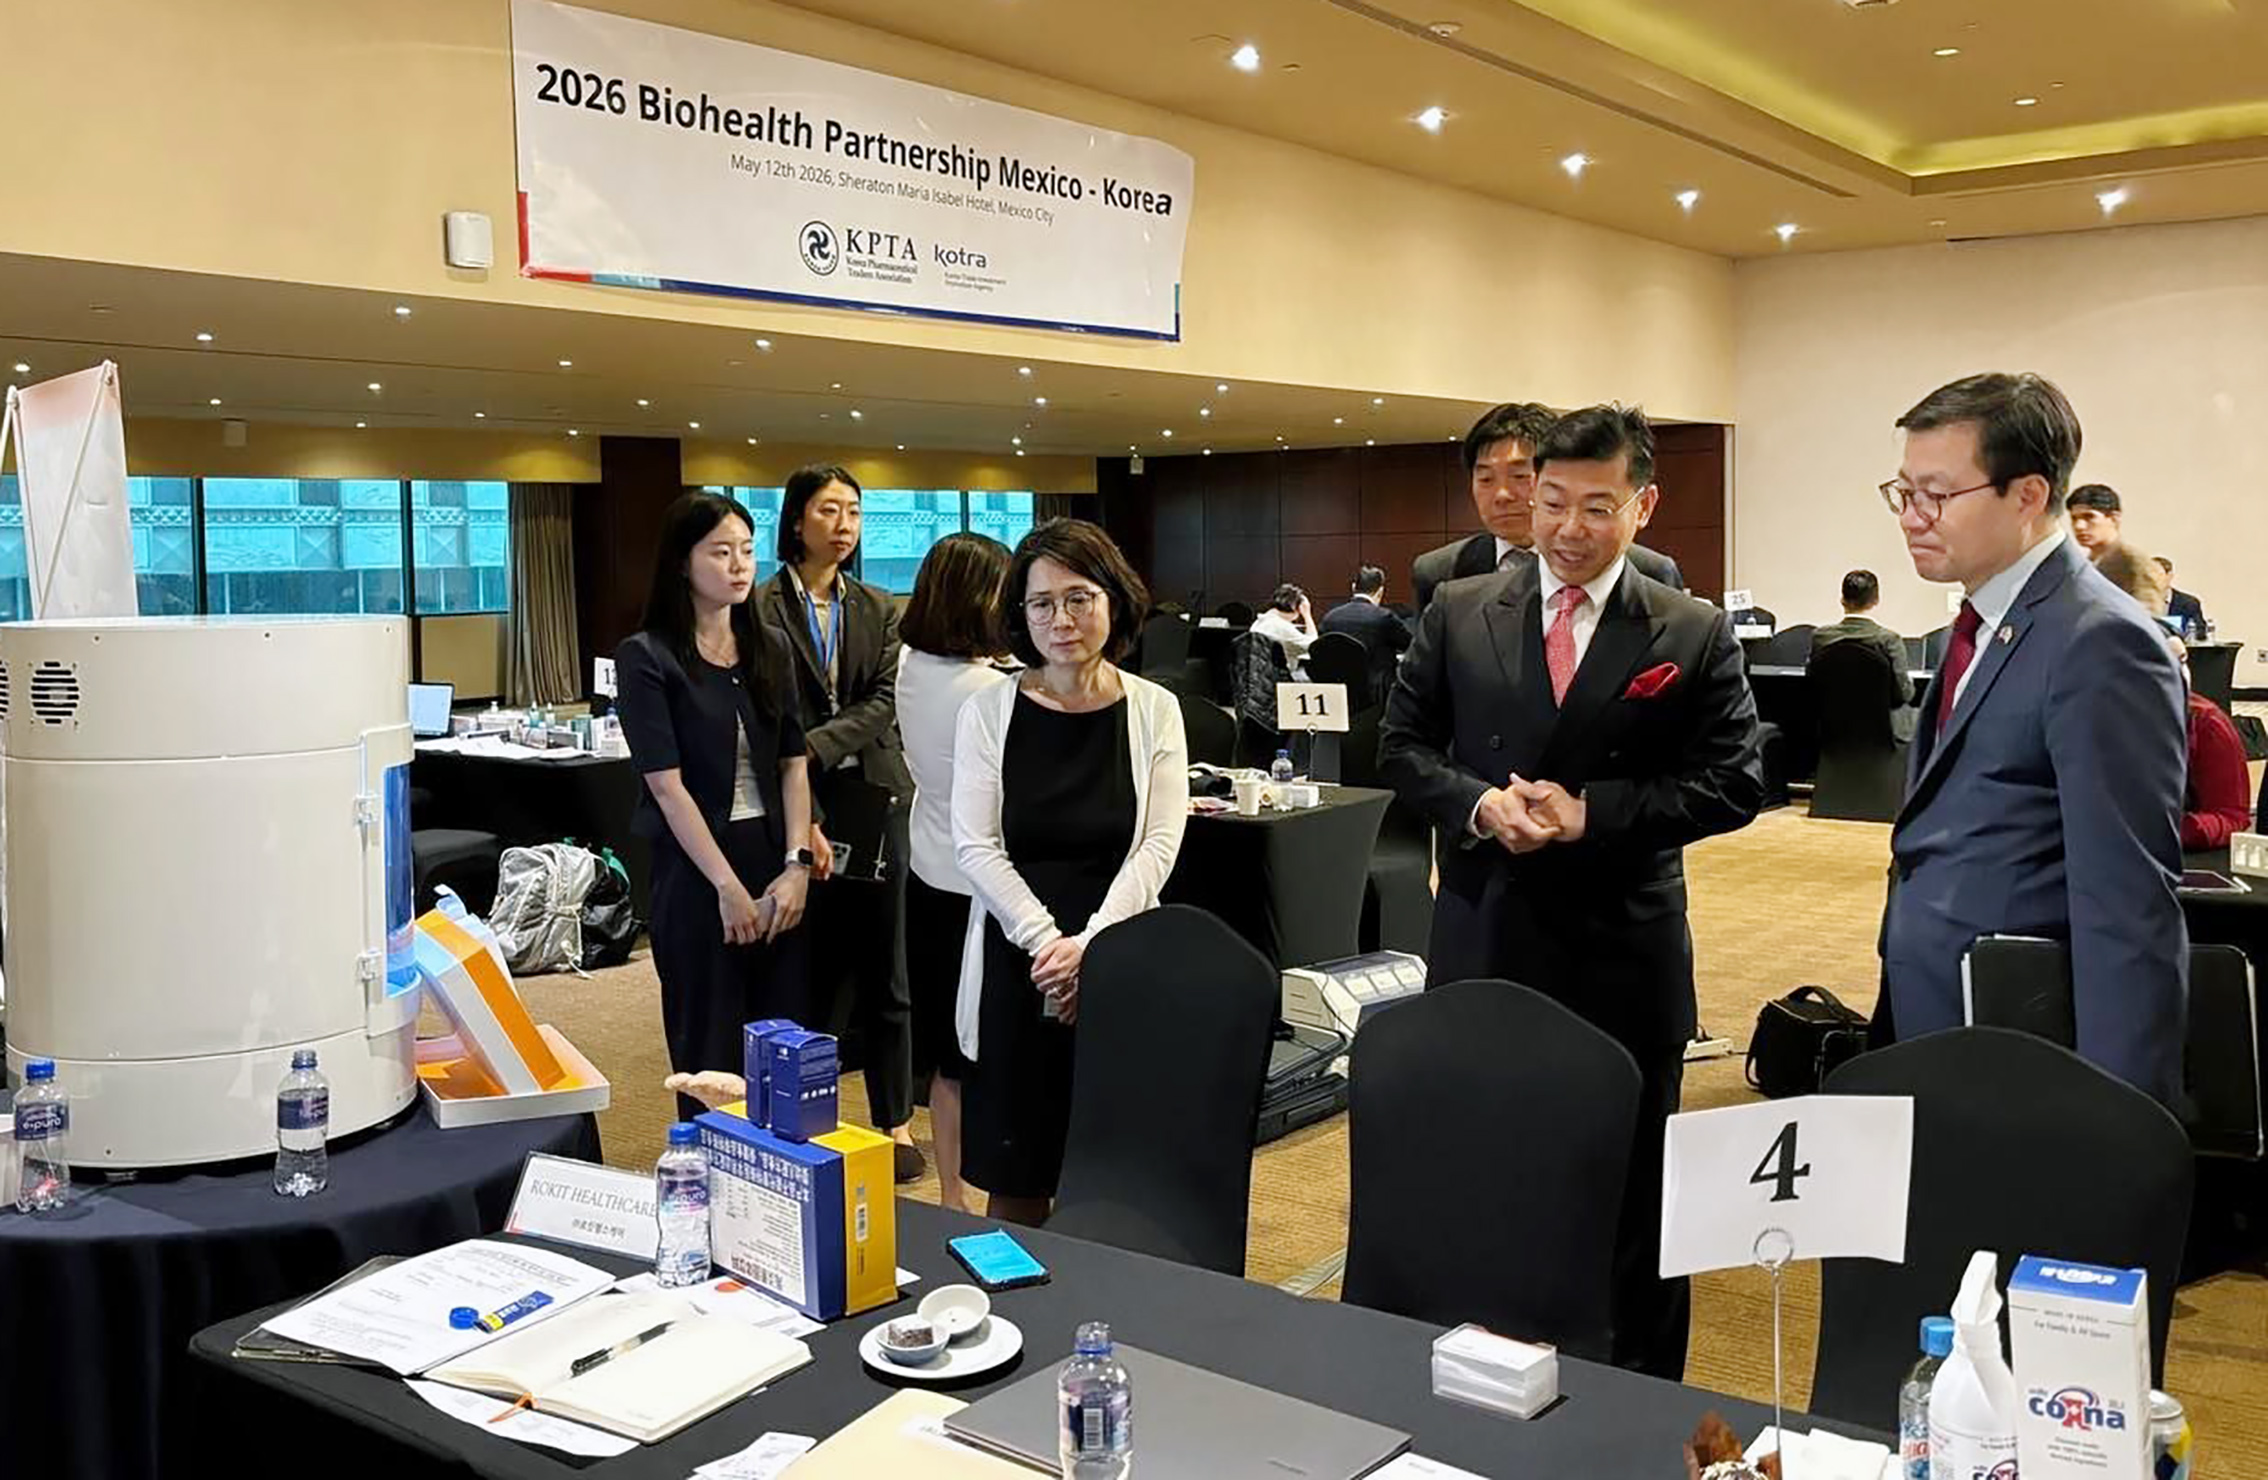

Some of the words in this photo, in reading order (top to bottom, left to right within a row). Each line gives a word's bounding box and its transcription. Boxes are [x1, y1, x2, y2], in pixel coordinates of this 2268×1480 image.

[536, 63, 627, 115] 2026
[638, 84, 813, 149] Biohealth
[825, 120, 990, 190] Partnership
[1000, 156, 1082, 200] Mexico
[1103, 178, 1173, 216] Korea
[731, 154, 761, 177] May
[766, 160, 795, 178] 12th
[800, 165, 835, 187] 2026,
[838, 171, 894, 195] Sheraton
[898, 182, 930, 201] Maria
[932, 188, 964, 207] Isabel
[1000, 201, 1033, 219] Mexico
[1035, 208, 1054, 226] City
[846, 229, 918, 262] KPTA
[935, 244, 986, 268] kotra
[1296, 693, 1329, 716] 11
[1749, 1121, 1811, 1203] 4
[530, 1179, 568, 1201] ROKIT
[572, 1186, 657, 1217] HEALTHCARE
